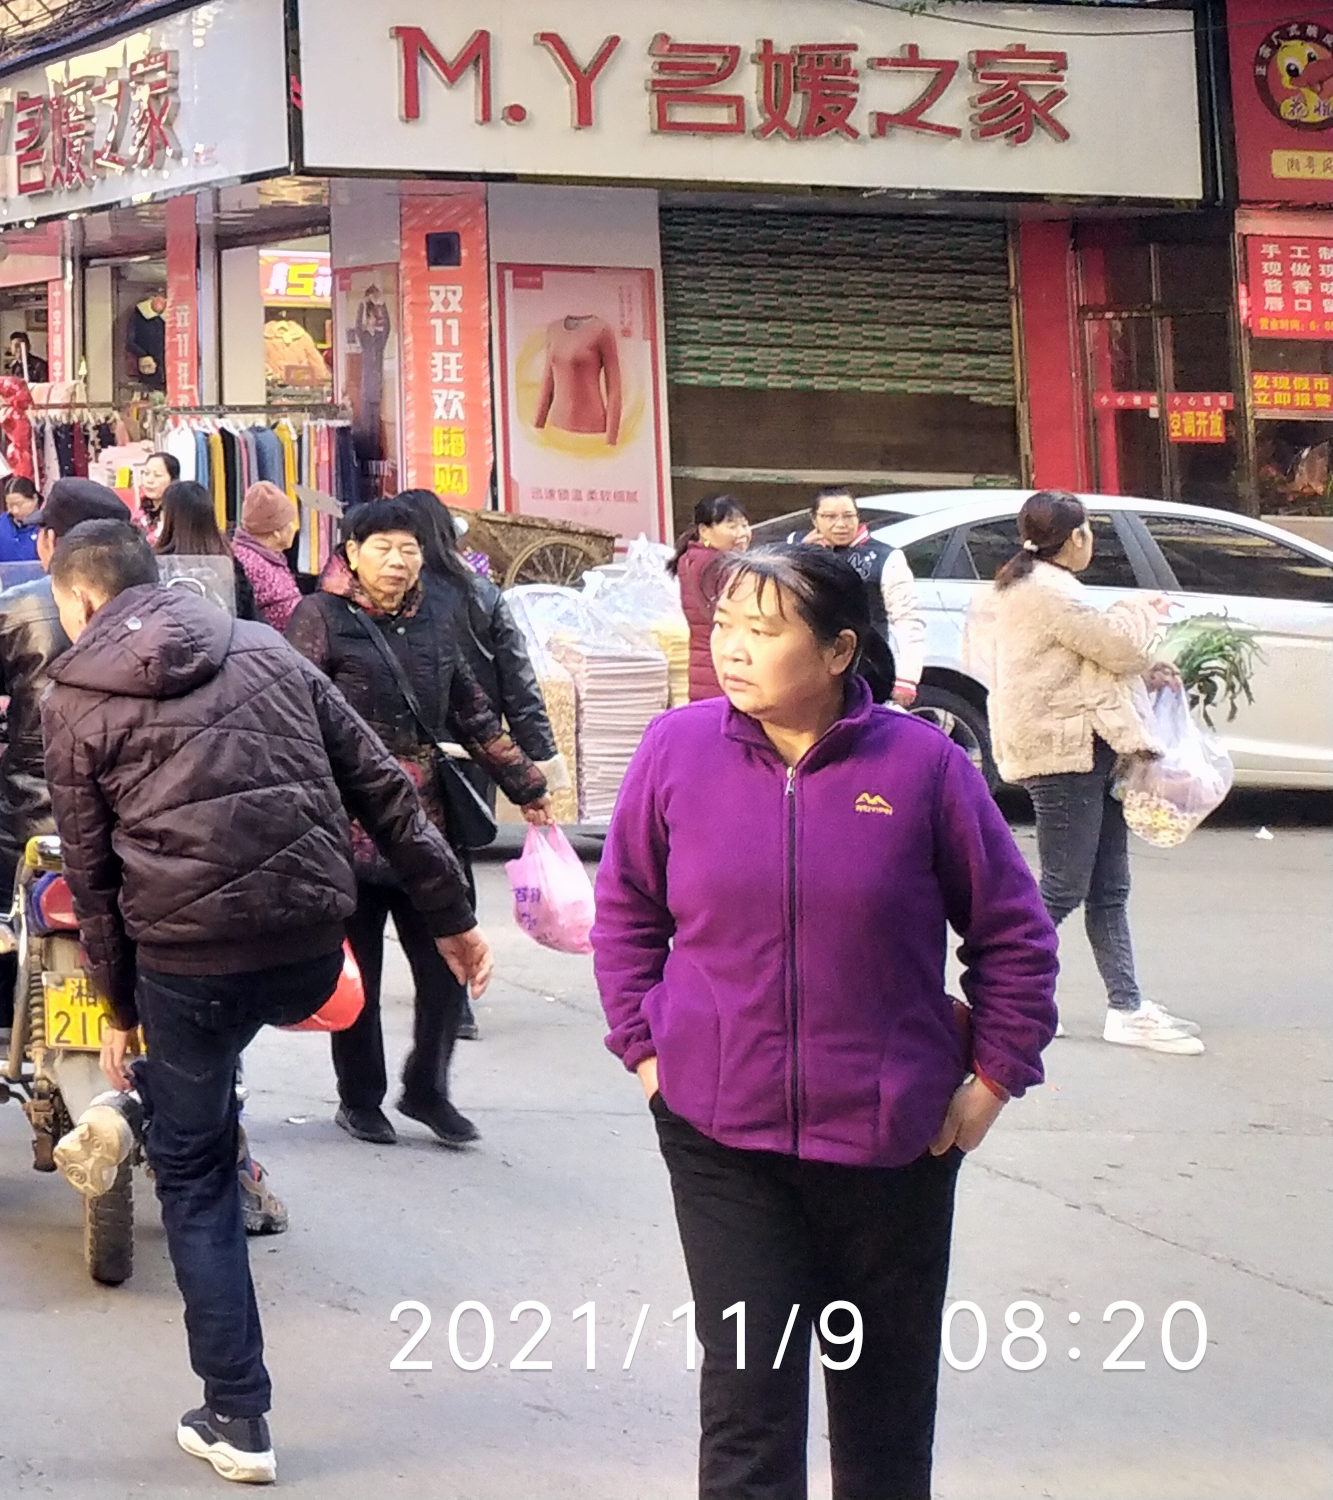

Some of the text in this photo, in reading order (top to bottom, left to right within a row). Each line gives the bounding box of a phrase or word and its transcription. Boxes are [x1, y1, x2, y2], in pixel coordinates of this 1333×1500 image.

[427, 283, 469, 496] 双11狂欢嗨购
[1253, 375, 1329, 391] 发现假币
[1253, 391, 1331, 408] 立即报警
[1169, 410, 1223, 438] 空调开放
